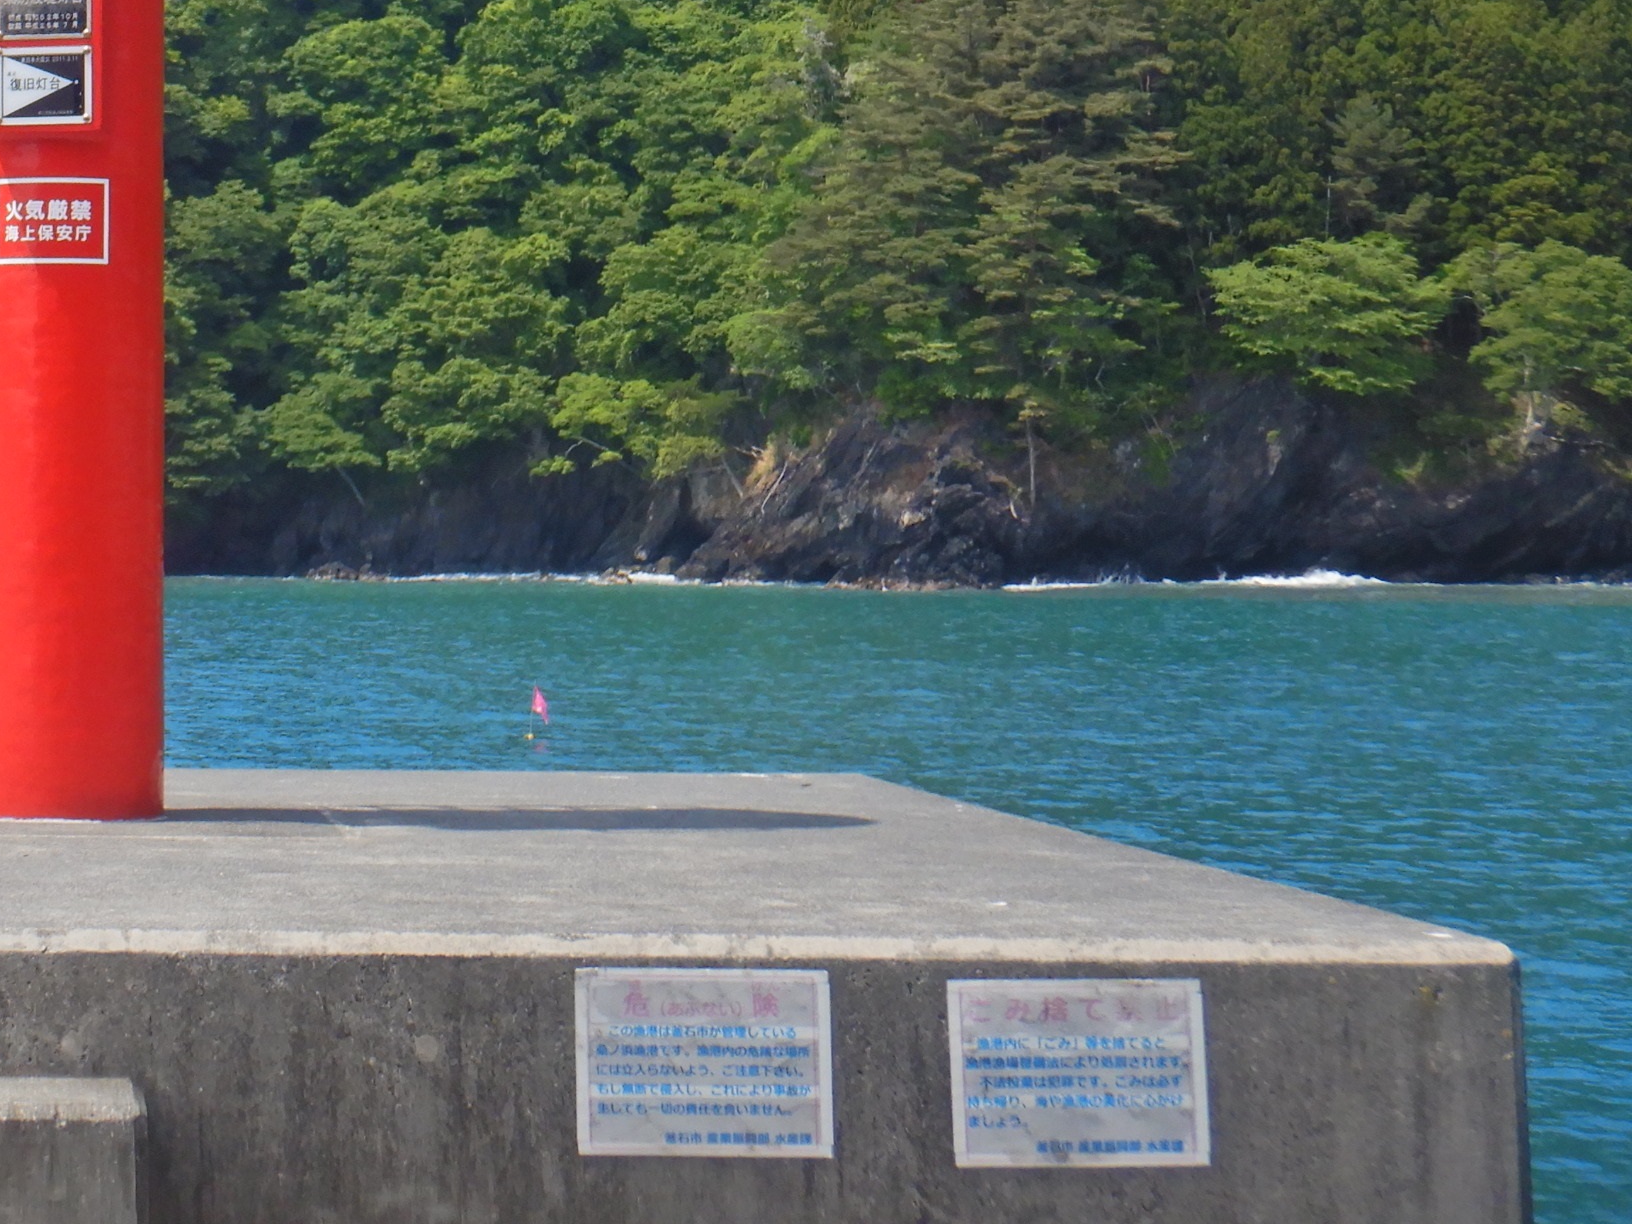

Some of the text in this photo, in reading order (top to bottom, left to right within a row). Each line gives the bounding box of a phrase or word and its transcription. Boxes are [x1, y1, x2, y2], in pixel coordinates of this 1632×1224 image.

[10, 77, 61, 92] 復旧灯台
[5, 199, 92, 221] 火気厳禁
[4, 224, 92, 242] 海上保安庁
